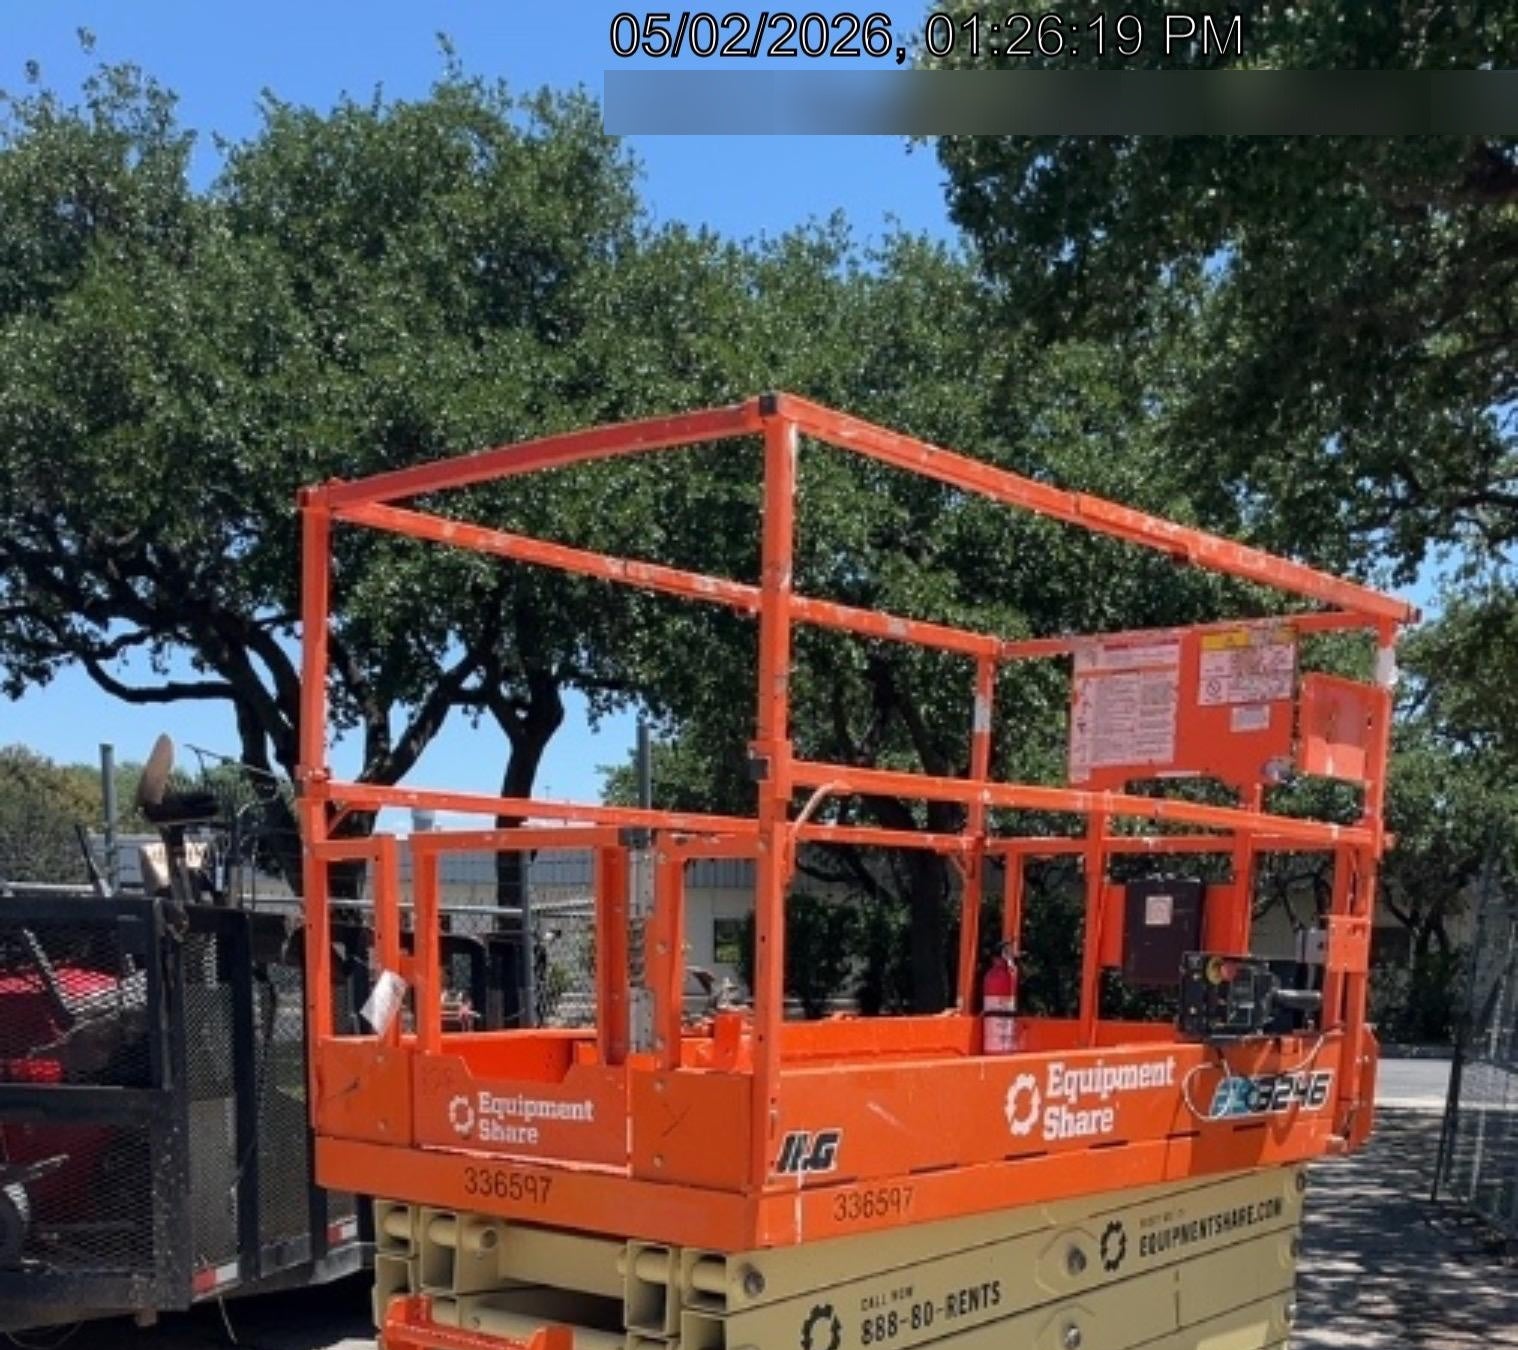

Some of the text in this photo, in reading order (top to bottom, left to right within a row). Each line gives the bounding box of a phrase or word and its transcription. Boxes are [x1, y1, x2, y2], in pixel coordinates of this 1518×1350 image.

[1046, 1056, 1175, 1102] Equipment
[477, 1091, 595, 1123] Equipment
[1043, 1104, 1114, 1141] Share
[478, 1118, 539, 1145] Share
[776, 1130, 842, 1175] JLG
[464, 1167, 552, 1203] 336597
[833, 1187, 914, 1222] 336597
[1139, 1197, 1284, 1258] EQUIPMENTSHARE.COM
[860, 1279, 1002, 1346] 888-80-RENTS
